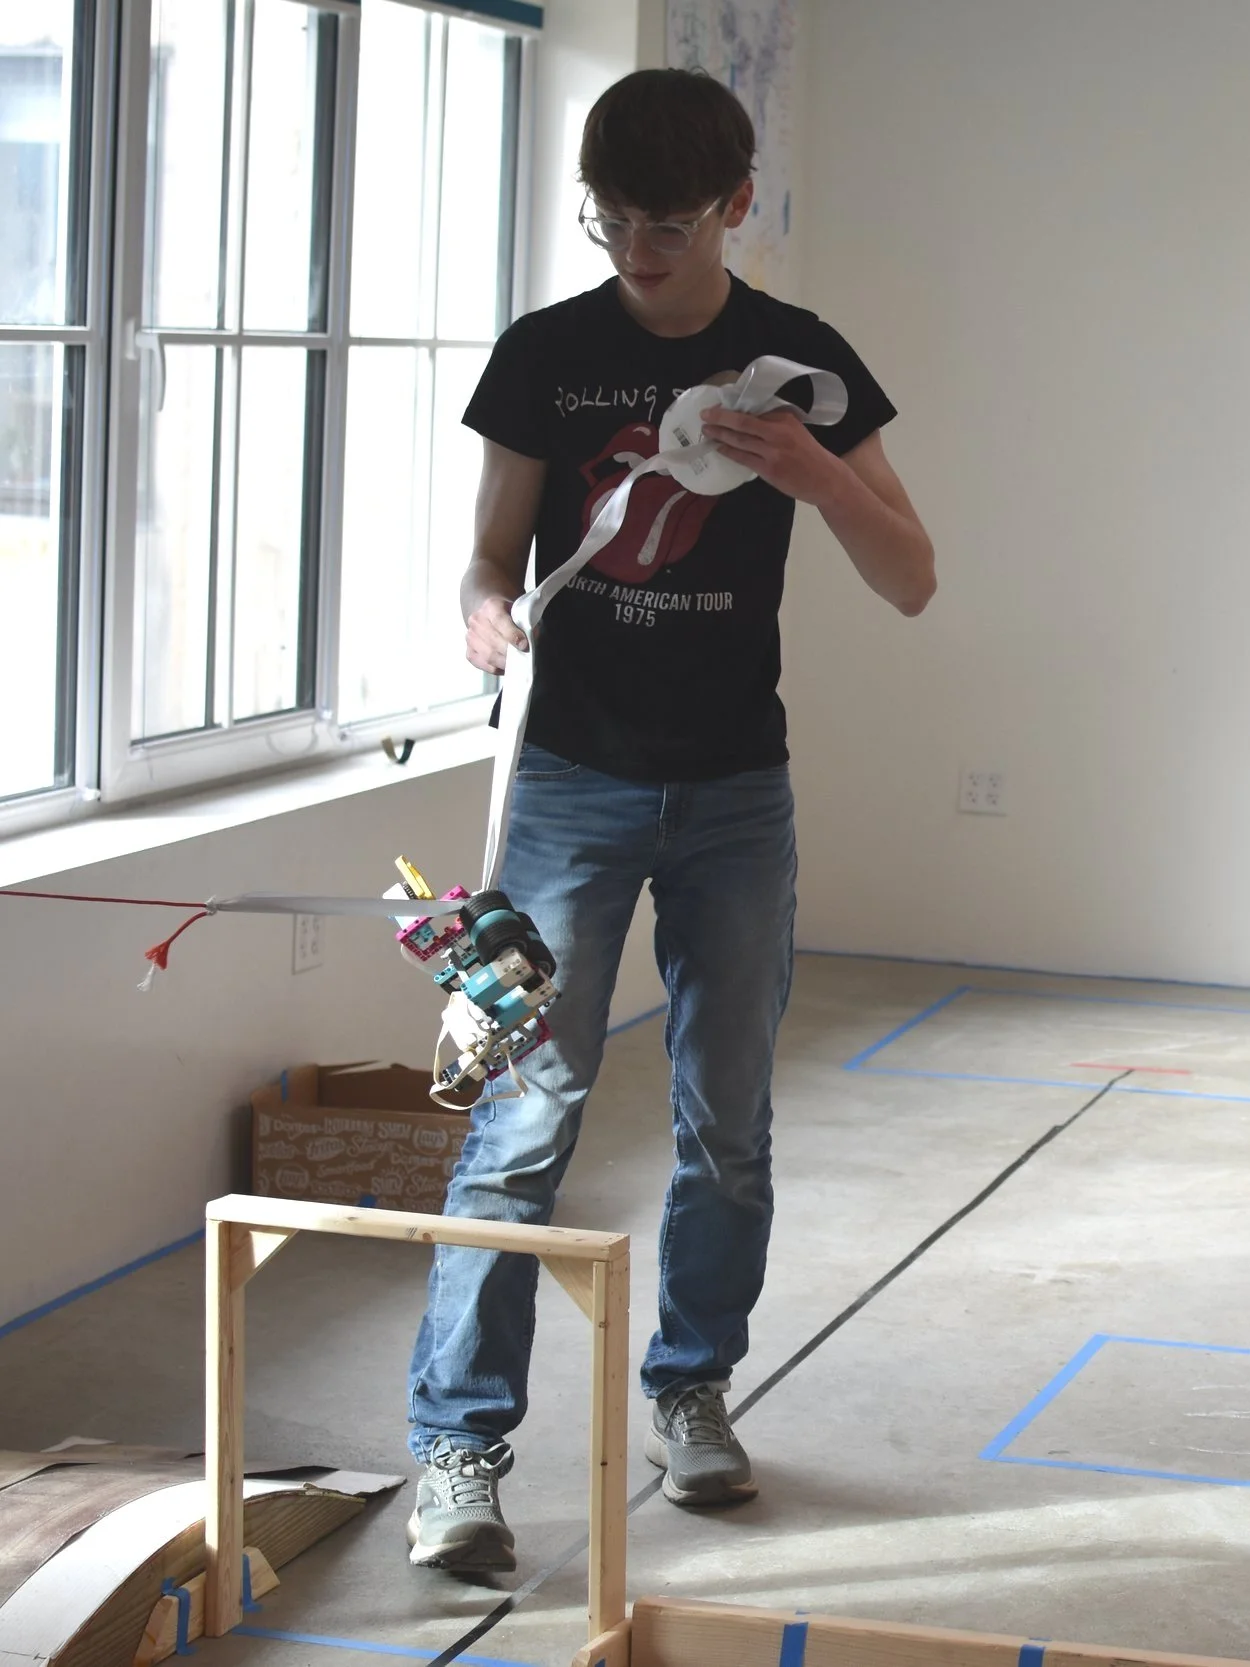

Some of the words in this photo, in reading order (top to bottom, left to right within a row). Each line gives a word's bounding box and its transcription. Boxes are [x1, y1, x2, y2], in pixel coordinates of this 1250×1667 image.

[566, 575, 606, 595] ORTH
[609, 585, 692, 611] AMERICAN
[696, 592, 733, 611] TOUR
[615, 604, 656, 627] 1975
